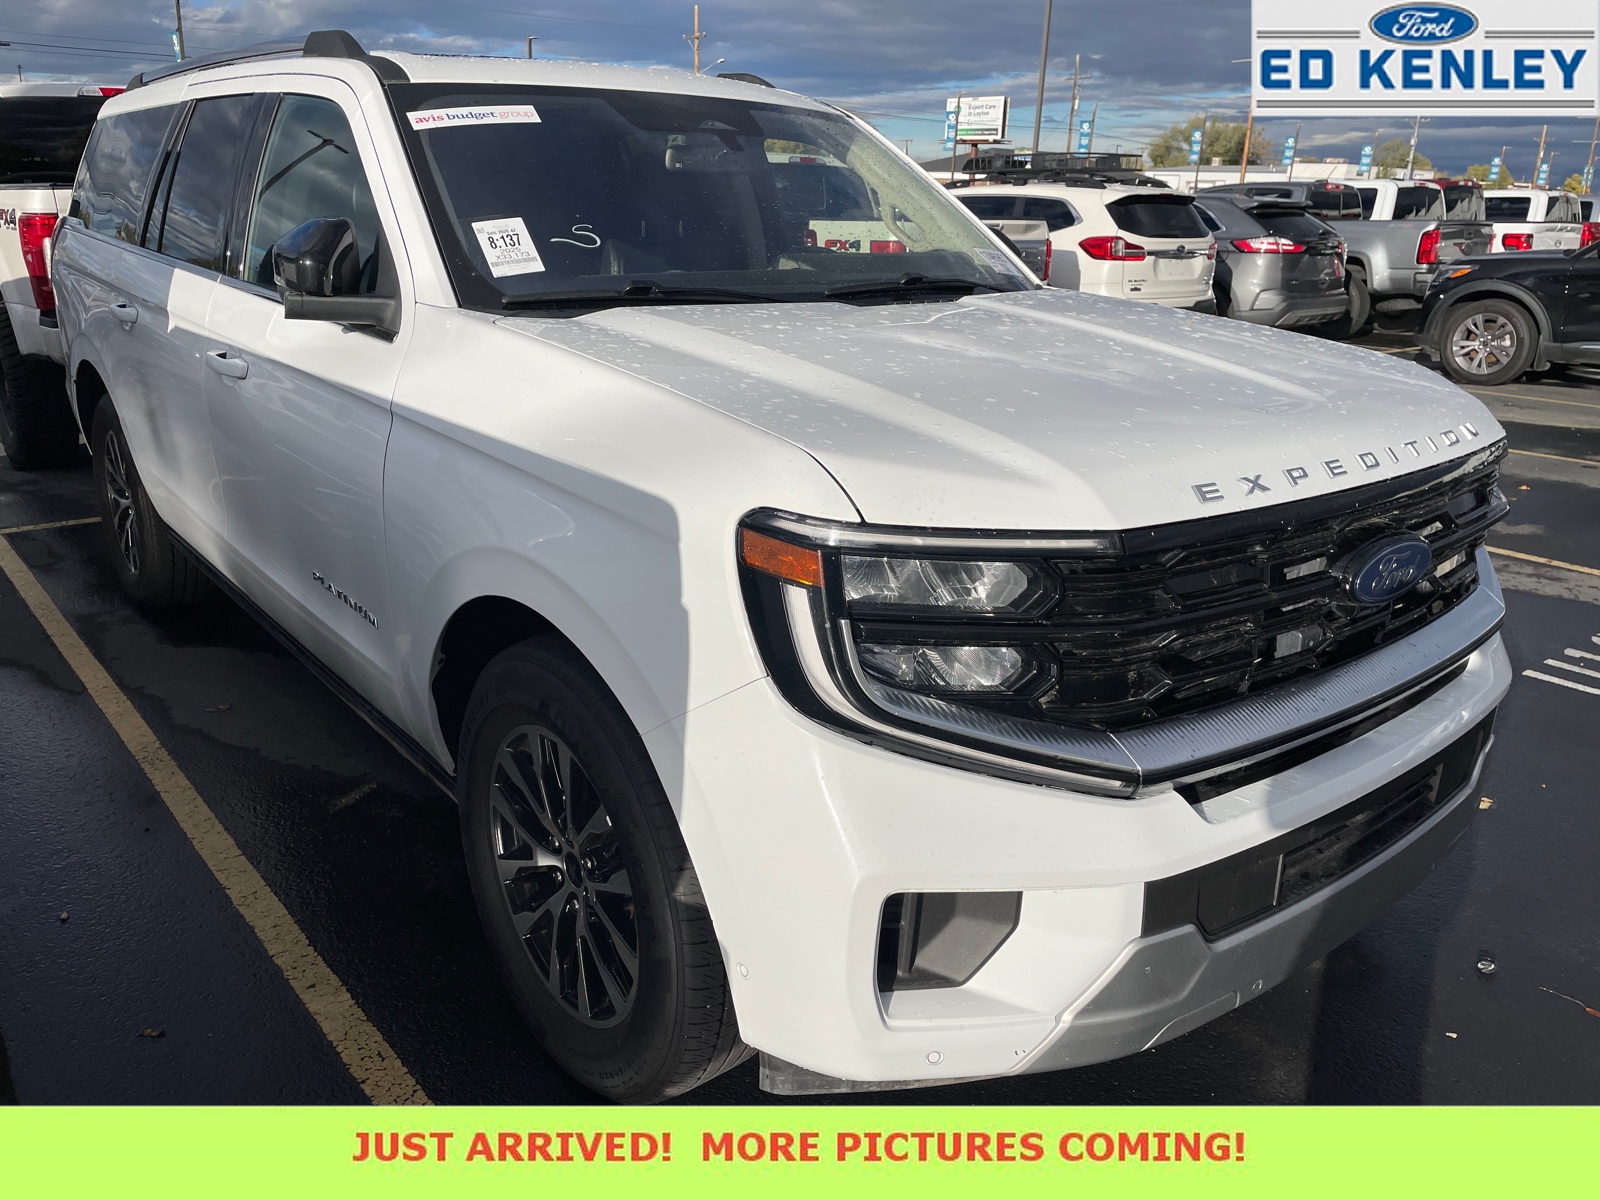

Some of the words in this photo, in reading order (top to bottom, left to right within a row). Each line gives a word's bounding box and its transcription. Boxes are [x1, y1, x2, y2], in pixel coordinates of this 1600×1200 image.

[415, 114, 445, 124] avis
[445, 111, 497, 120] budget
[498, 111, 534, 119] group
[487, 233, 521, 250] 8:137
[1191, 422, 1479, 504] EXPEDITION
[1371, 550, 1421, 595] Ford
[312, 570, 379, 629] PLATINUM
